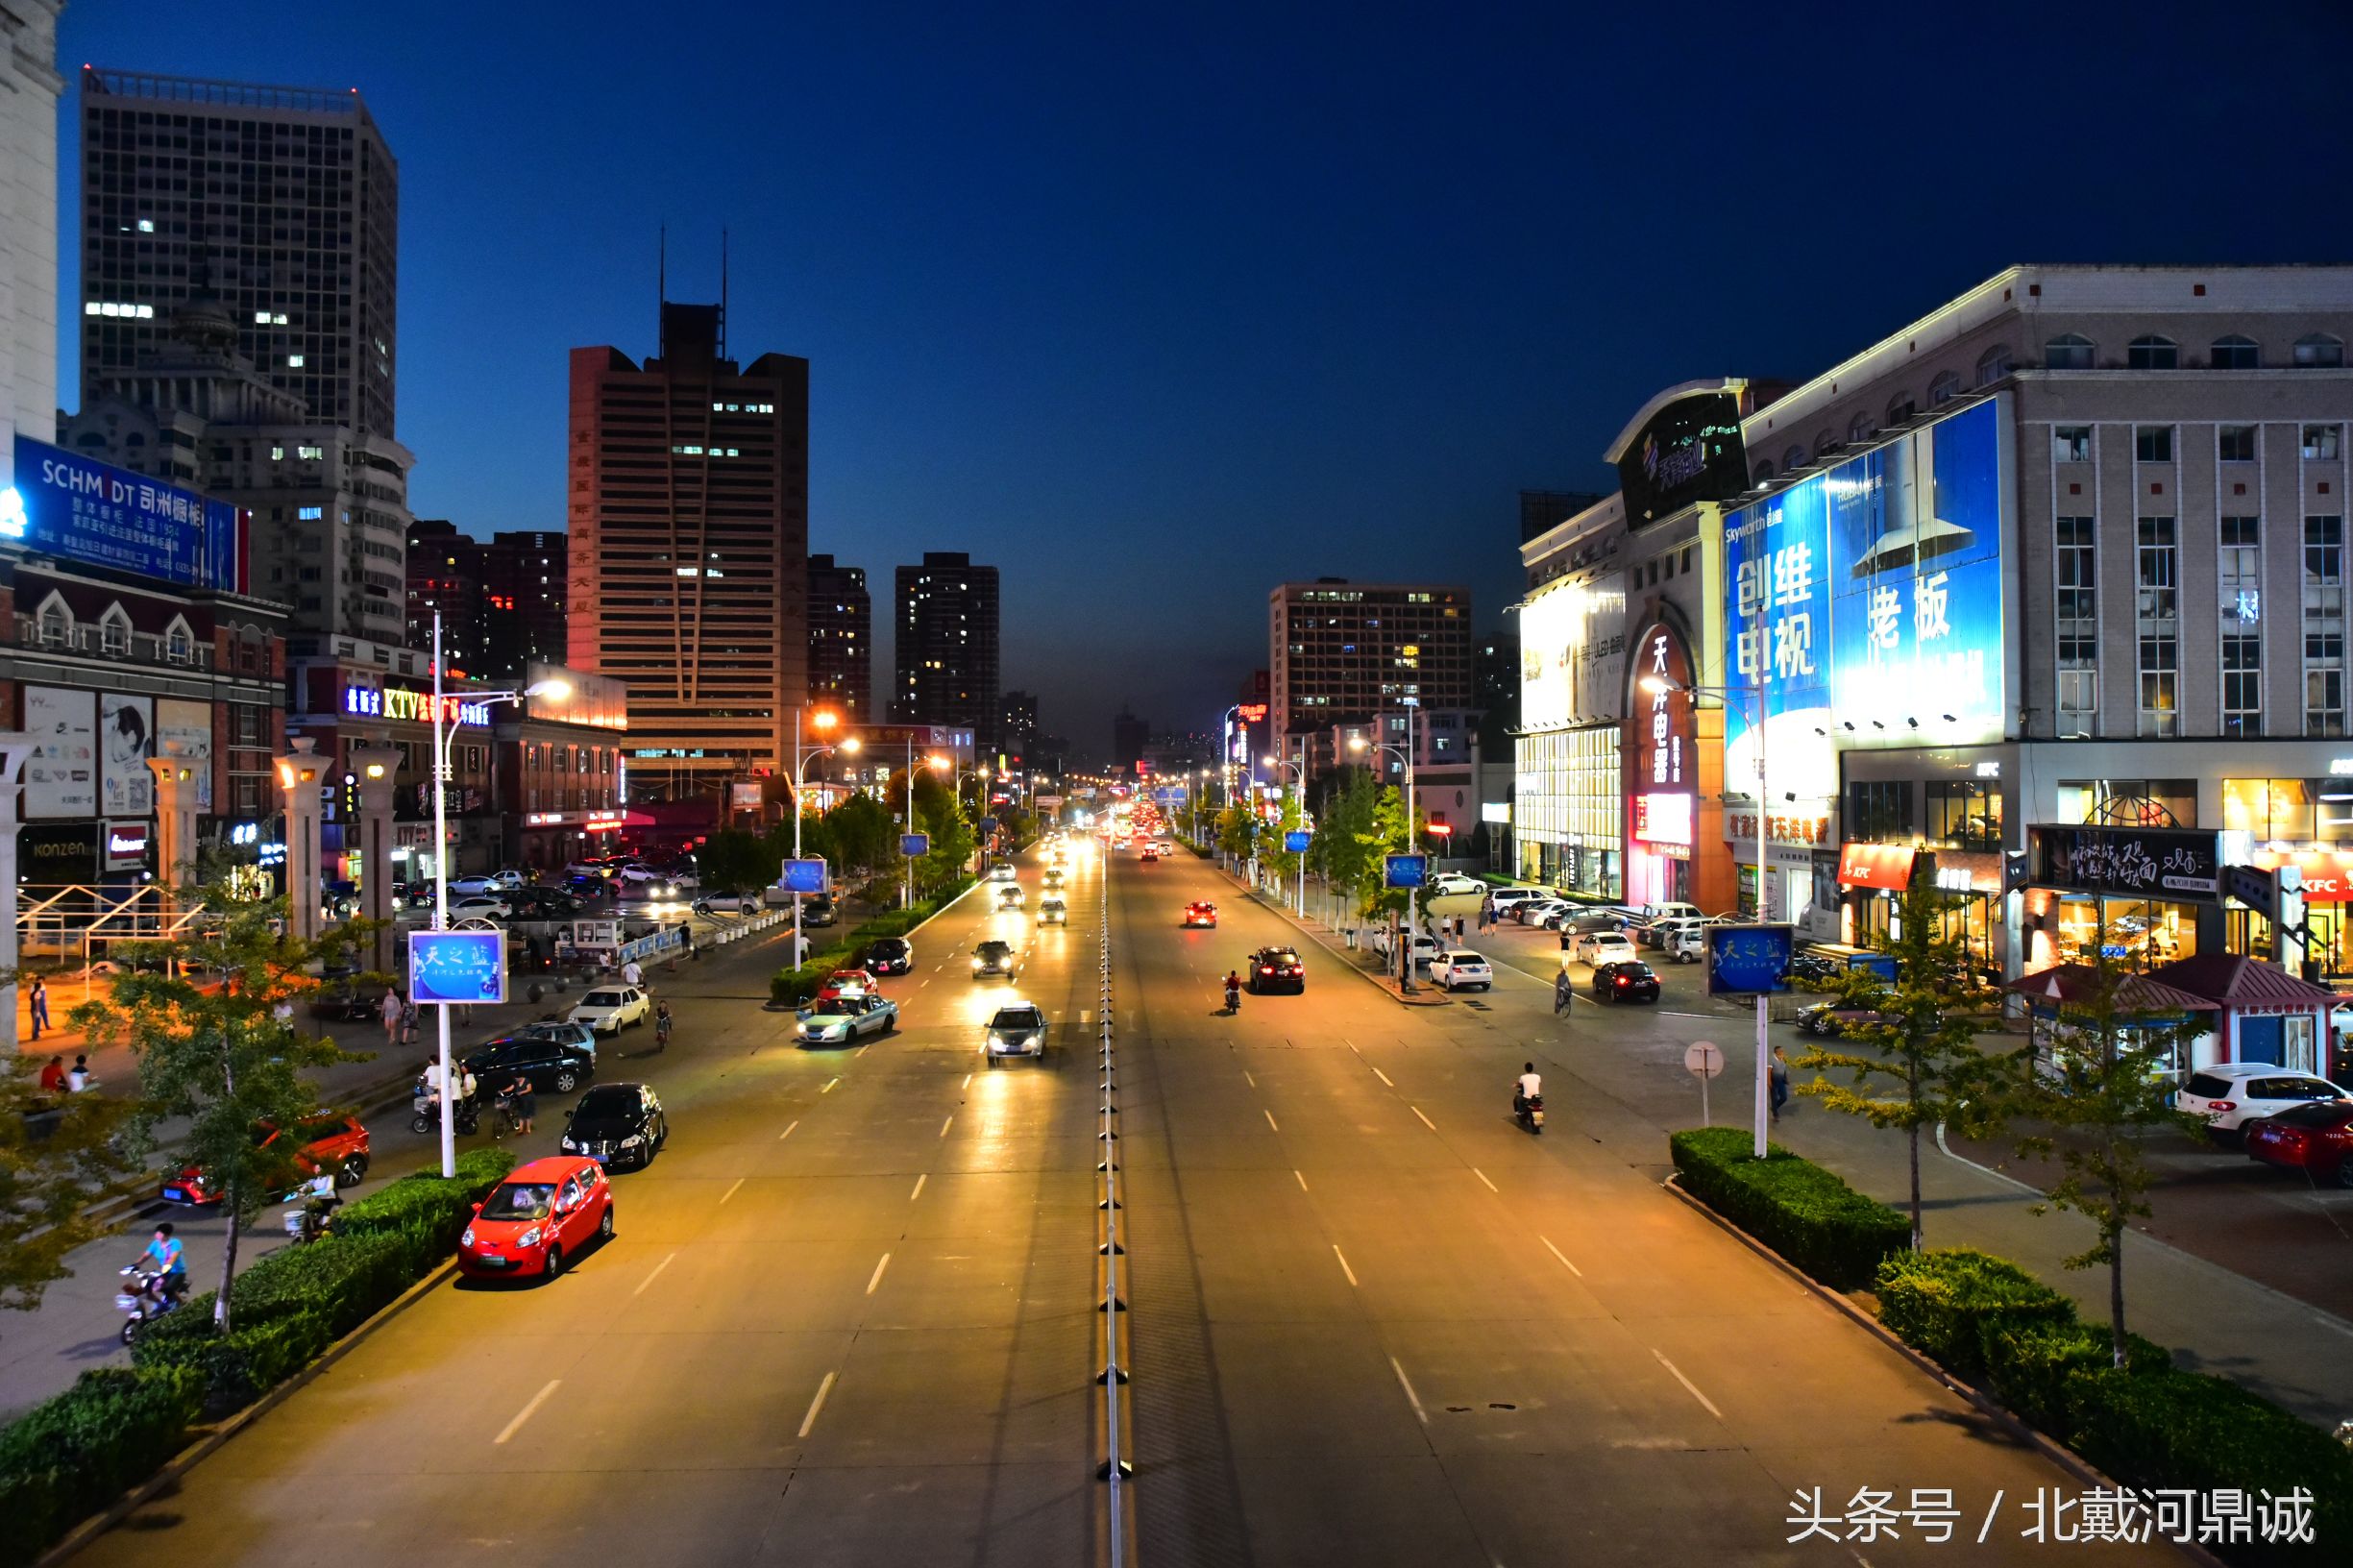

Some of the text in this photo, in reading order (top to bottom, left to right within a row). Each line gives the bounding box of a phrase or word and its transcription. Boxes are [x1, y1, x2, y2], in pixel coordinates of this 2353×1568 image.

[1726, 516, 1766, 543] Skyworth
[1736, 541, 1812, 617] 创维
[1870, 571, 1951, 649] 老板
[1736, 612, 1815, 685] 电视
[383, 688, 419, 720] KTV
[1852, 867, 1871, 879] KFC
[2301, 879, 2337, 893] KFC
